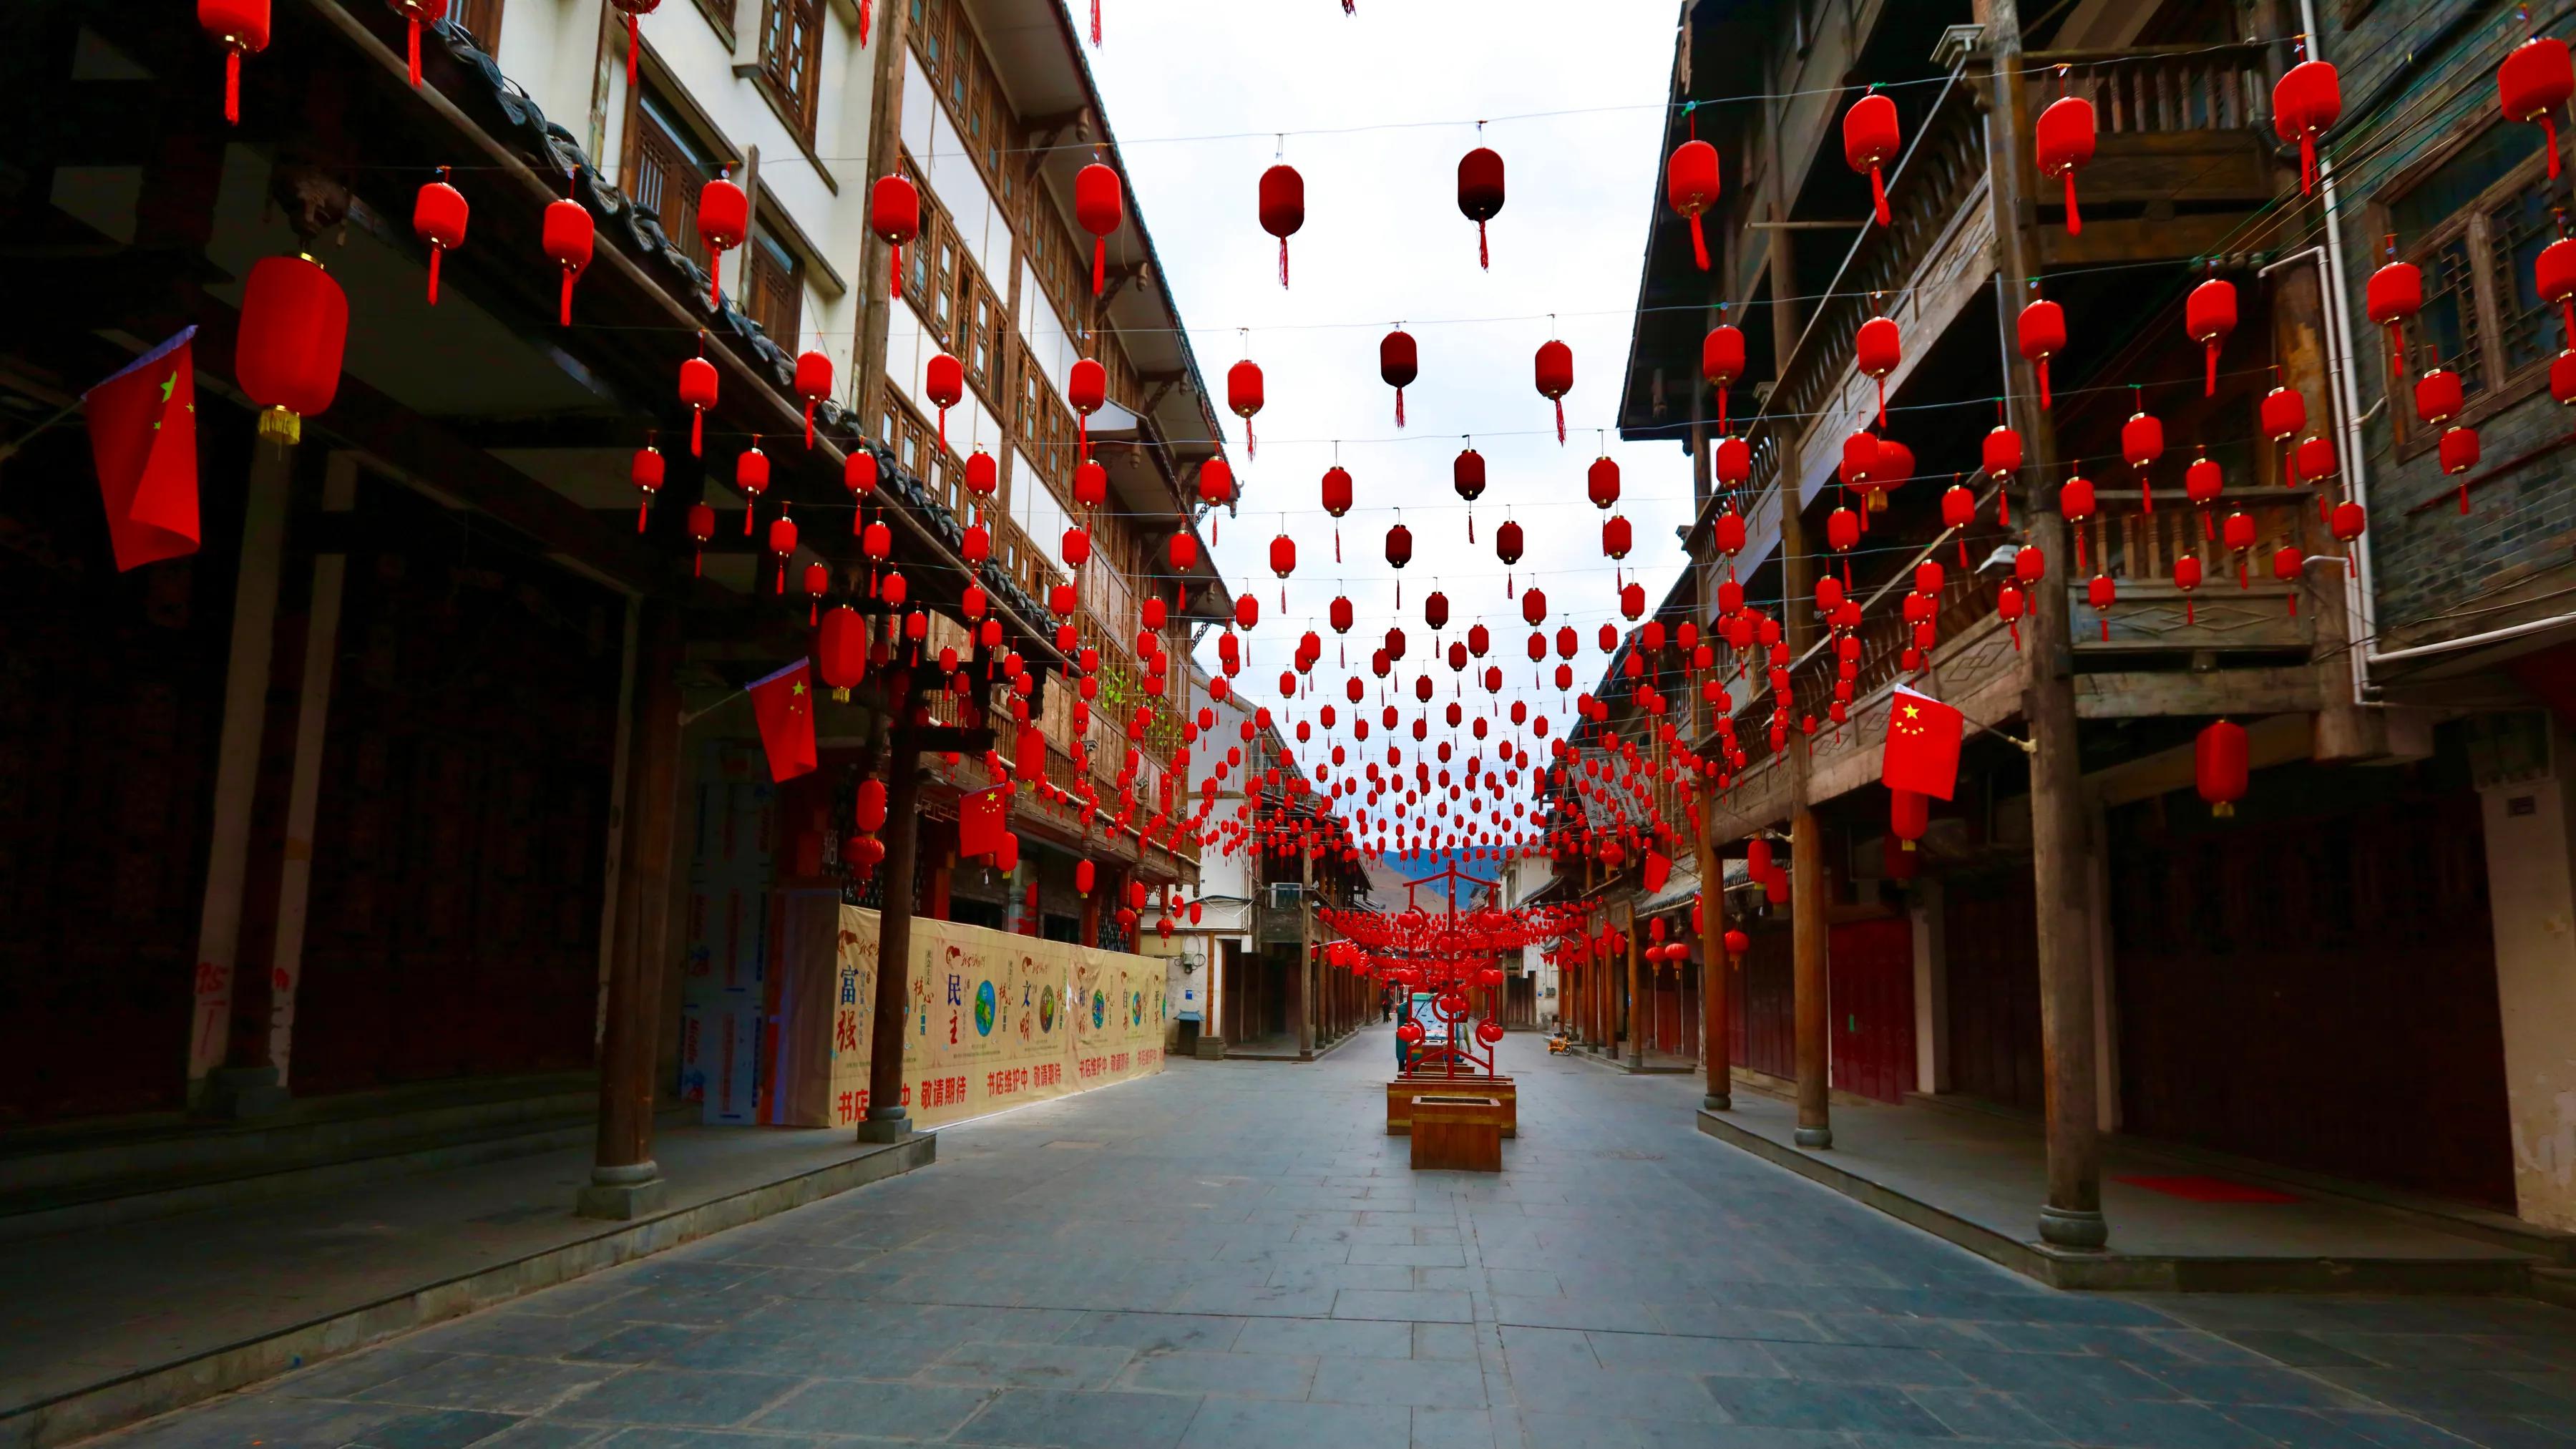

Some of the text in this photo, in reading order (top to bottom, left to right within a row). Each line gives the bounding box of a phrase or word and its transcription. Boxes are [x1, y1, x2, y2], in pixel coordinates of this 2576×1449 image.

[836, 965, 859, 1053] 富强
[947, 973, 962, 1045] 民主
[1019, 980, 1032, 1043] 文明
[687, 1018, 702, 1065] Middle
[987, 1062, 1062, 1098] 书店维护中 敬请期待
[1079, 1055, 1108, 1079] 书店维护中
[921, 1076, 967, 1110] 敬请期待
